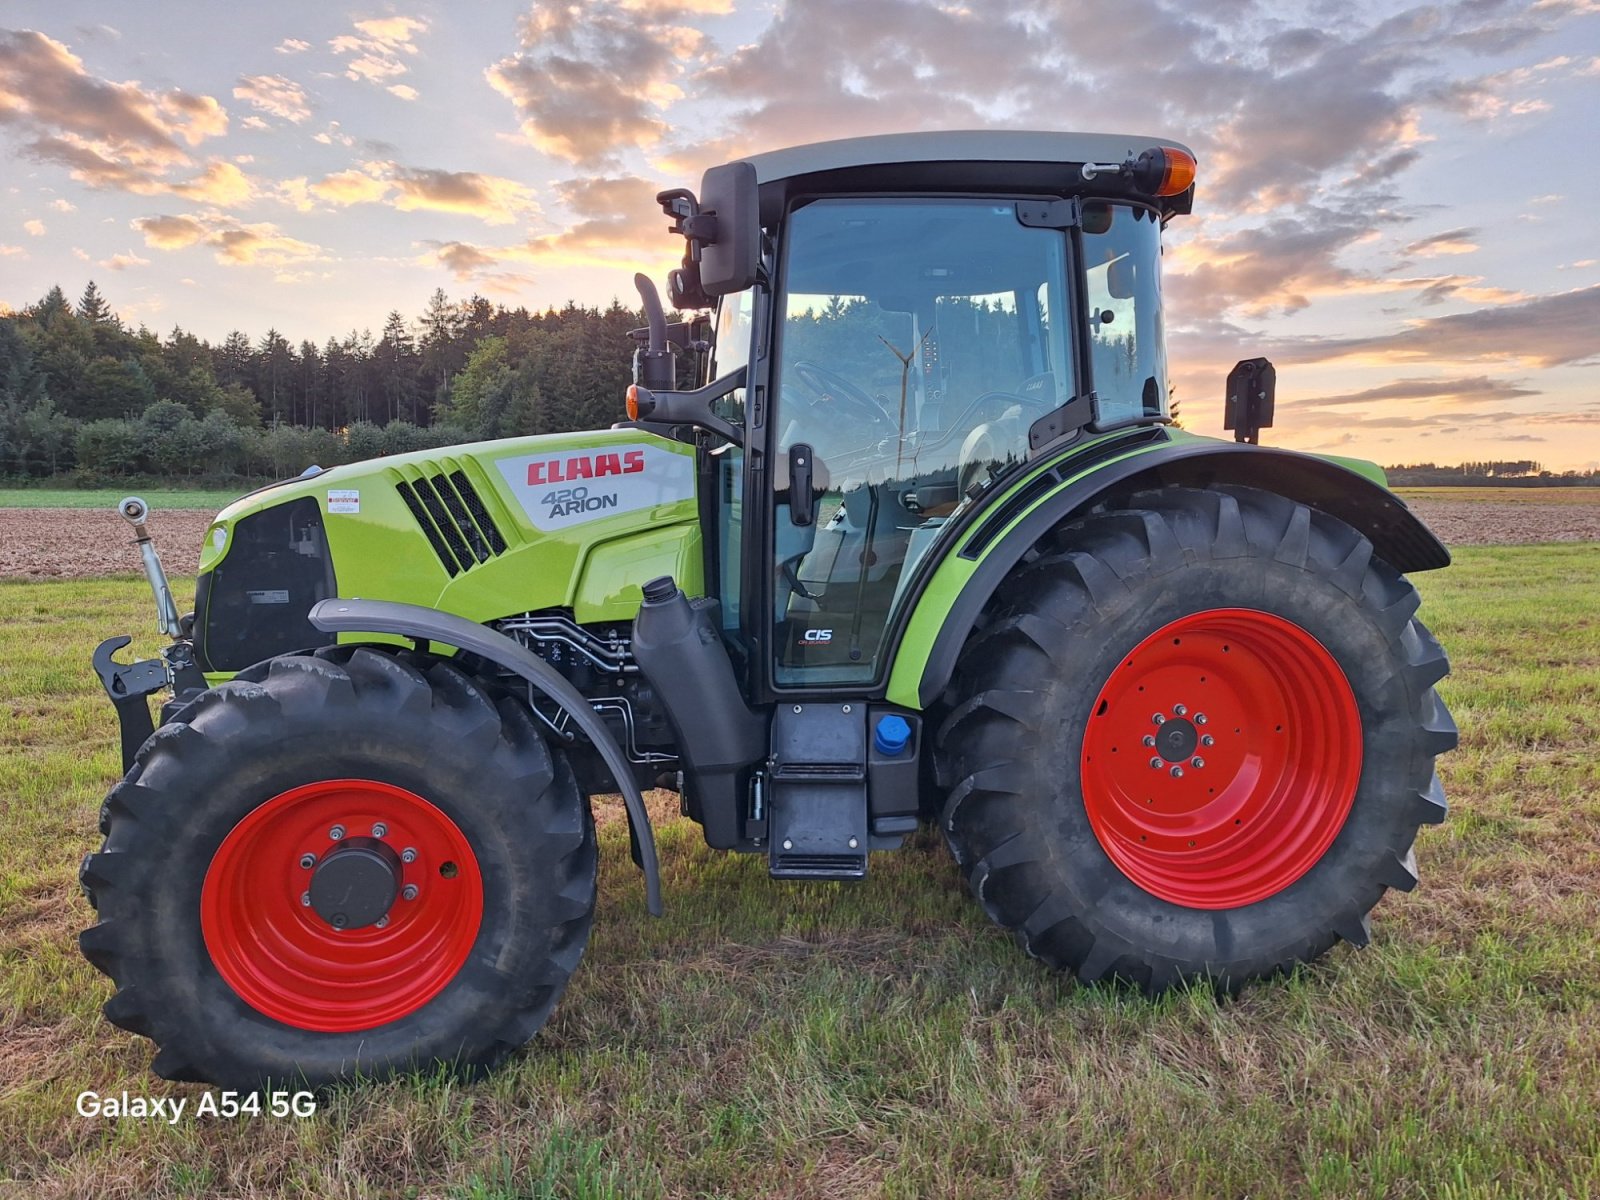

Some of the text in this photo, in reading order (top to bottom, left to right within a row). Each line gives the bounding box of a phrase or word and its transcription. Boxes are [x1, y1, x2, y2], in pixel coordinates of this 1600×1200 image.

[527, 451, 645, 486] CLAAS
[541, 487, 588, 504] 420
[548, 493, 618, 519] ARION
[804, 629, 833, 641] CIS
